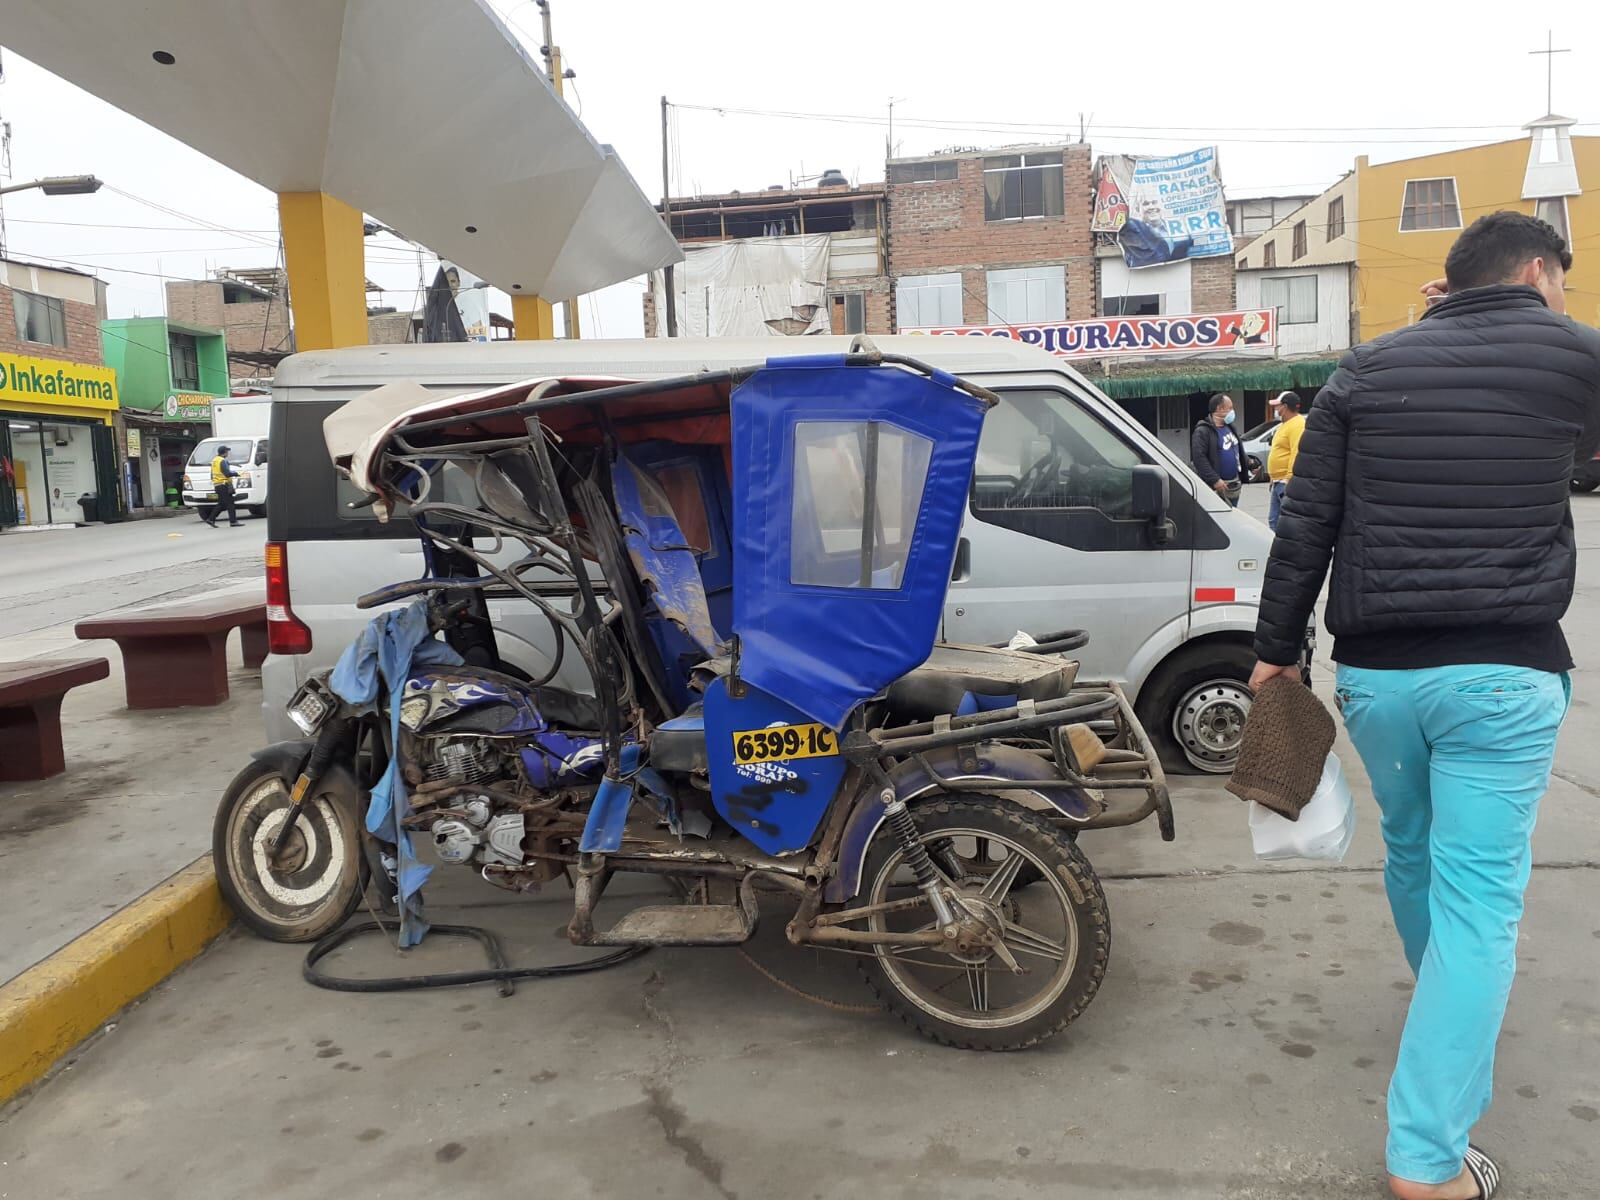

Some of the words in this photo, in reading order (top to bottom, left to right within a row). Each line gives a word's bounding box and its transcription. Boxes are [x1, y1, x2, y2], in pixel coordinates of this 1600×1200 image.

[1158, 175, 1217, 195] RAFAEL
[1019, 319, 1219, 352] PIURANOS
[10, 363, 113, 401] Inkafarma
